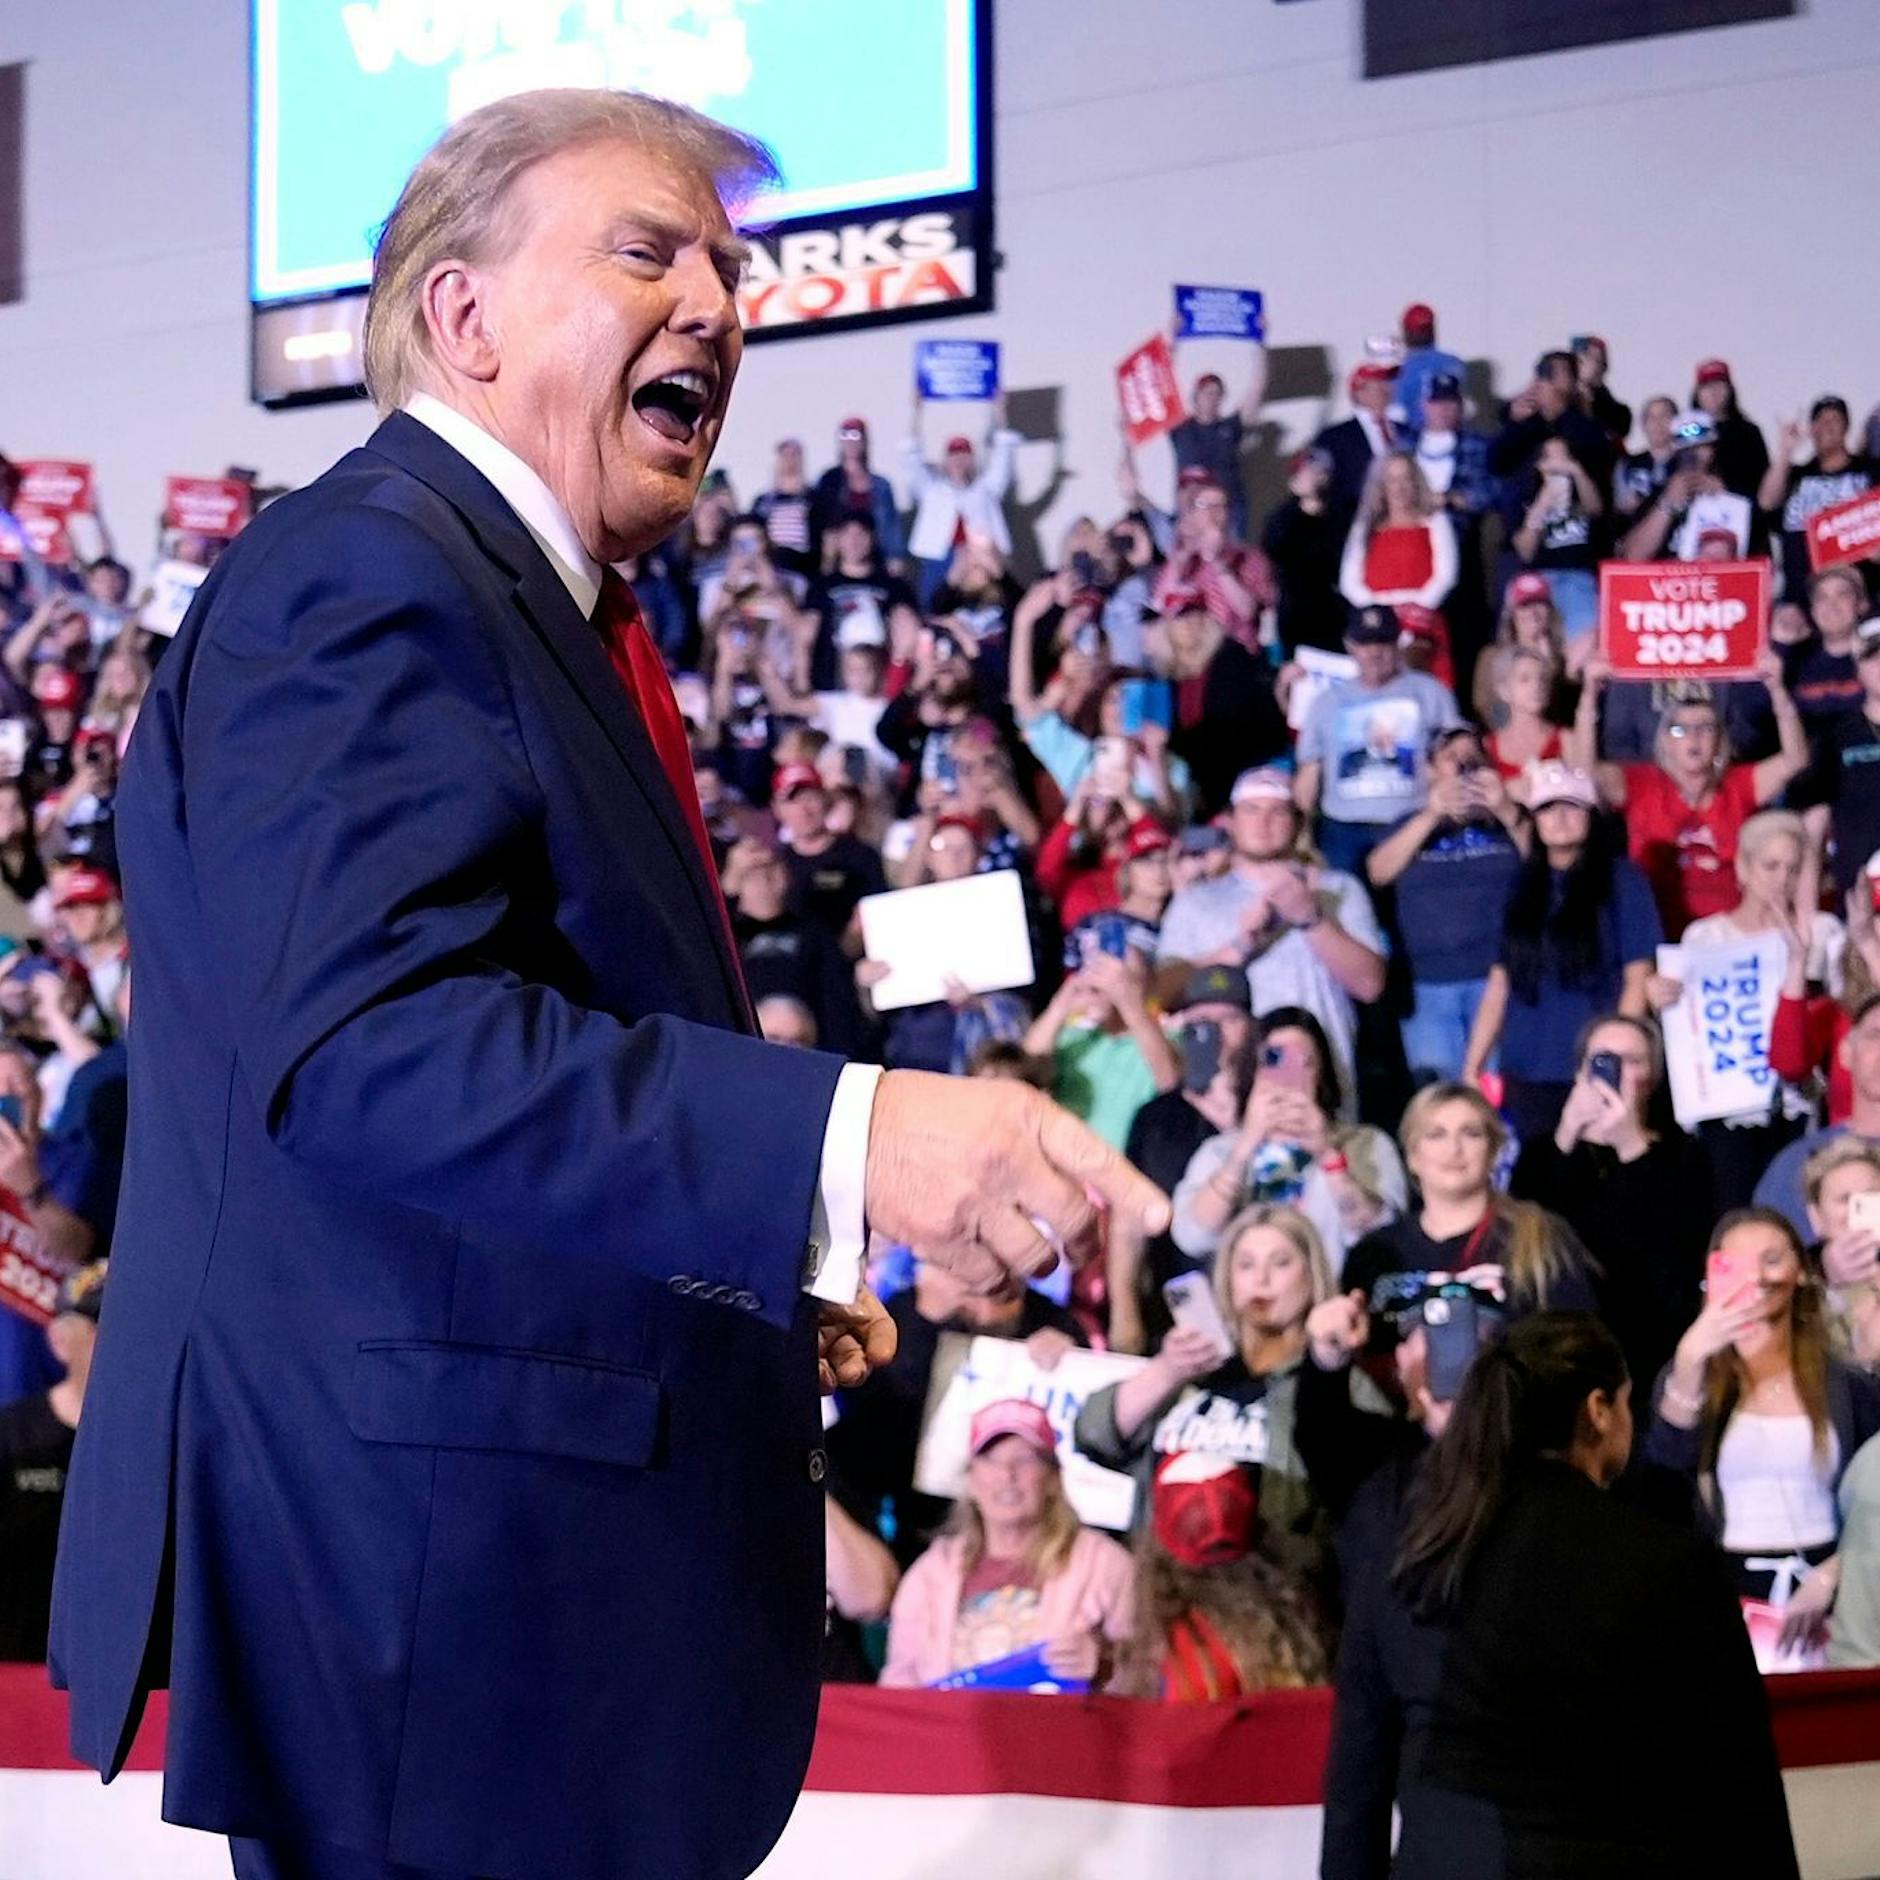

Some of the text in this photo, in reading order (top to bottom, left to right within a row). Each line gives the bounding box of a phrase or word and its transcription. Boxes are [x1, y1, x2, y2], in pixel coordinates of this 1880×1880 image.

[746, 212, 958, 281] ARKS
[743, 261, 965, 316] YOTA
[1620, 598, 1748, 632] TRUMP
[1650, 575, 1720, 601] VOTE
[1635, 631, 1729, 665] 2024
[1702, 975, 1737, 1073] 2024
[1733, 955, 1770, 1086] TRUMP
